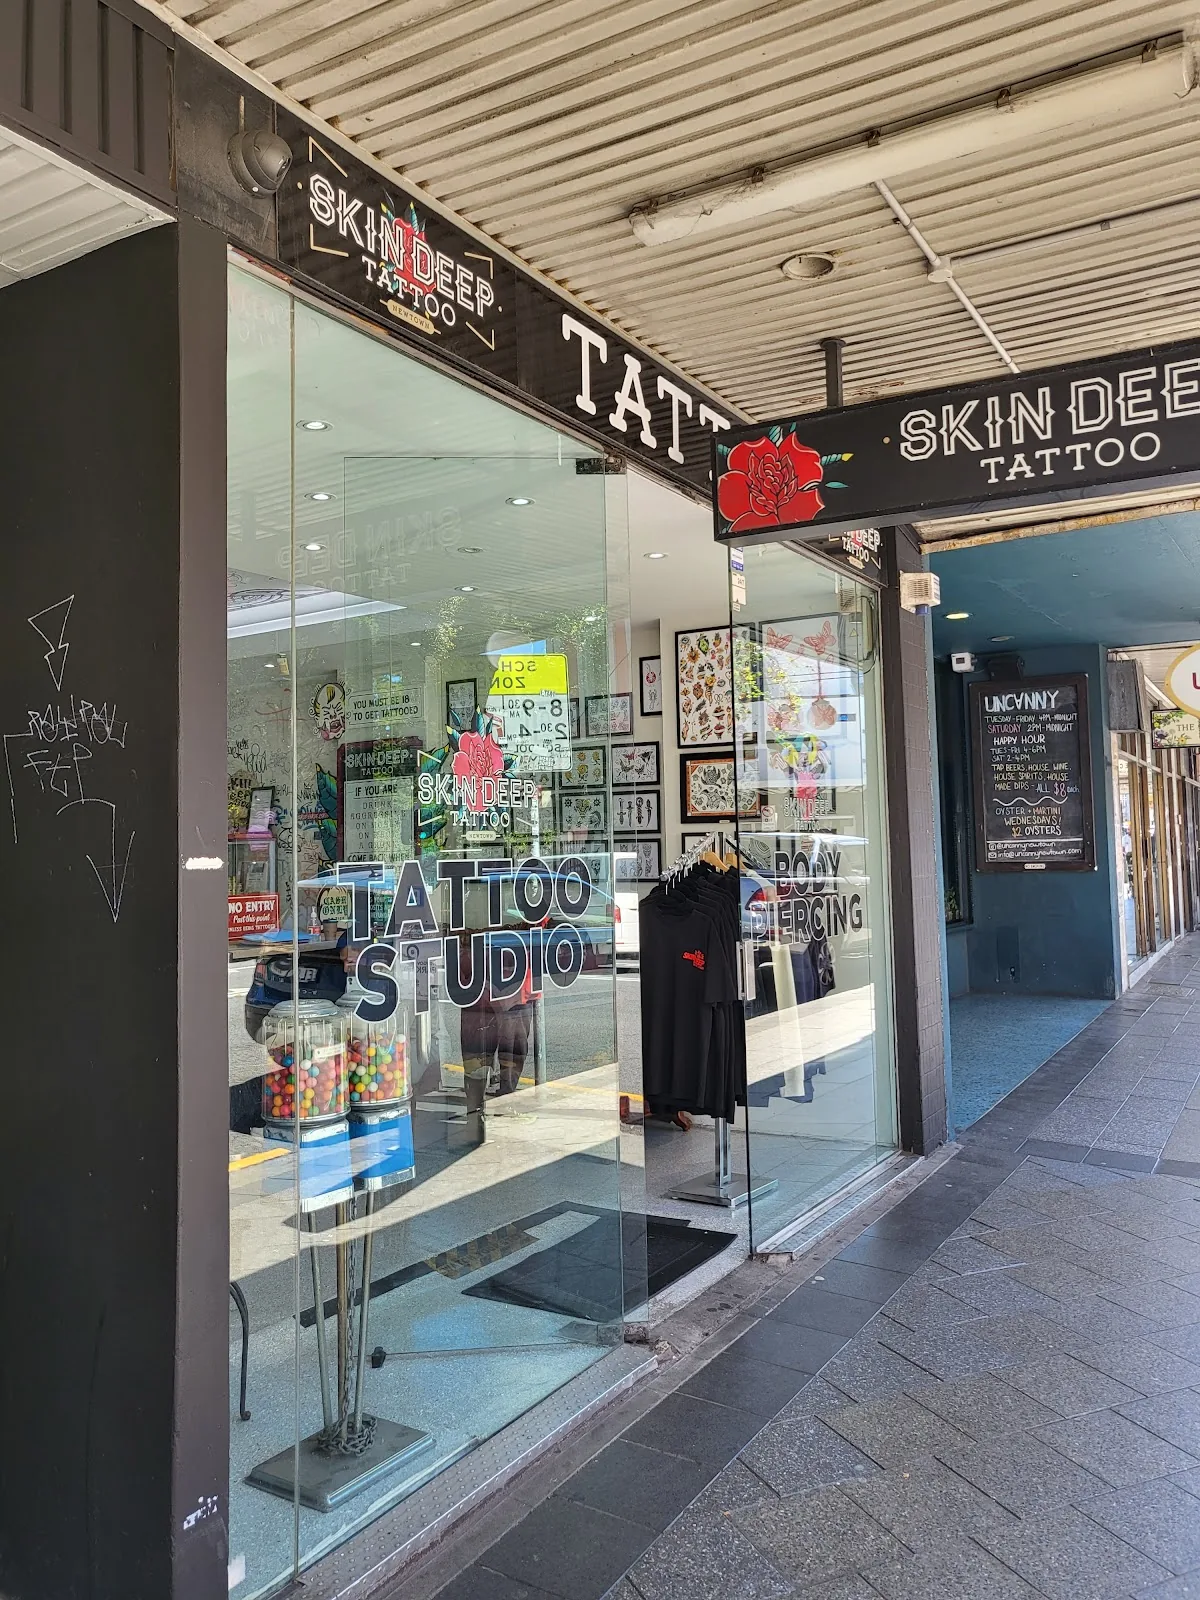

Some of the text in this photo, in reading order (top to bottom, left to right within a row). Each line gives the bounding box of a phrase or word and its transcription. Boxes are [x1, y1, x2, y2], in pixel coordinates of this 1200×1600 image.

[309, 174, 403, 271] SKIN
[410, 235, 494, 317] DEEP
[362, 256, 456, 326] TATTOO
[391, 304, 432, 331] NEWTOWN
[900, 386, 1056, 462] SKIN
[980, 431, 1161, 484] TATTOO
[353, 694, 410, 709] YOU MUST BE 18
[353, 705, 418, 721] TO GET TATTOOED
[987, 723, 1021, 734] SATURDAY
[1176, 723, 1195, 732] THE
[993, 734, 1046, 746] HAPPY HOUR
[346, 749, 410, 768] SKIN DEEP
[991, 755, 1004, 763] SAT
[361, 766, 394, 776] TATTOO
[1028, 763, 1050, 771] HOUSE
[994, 773, 1016, 781] HOUSE
[1047, 772, 1070, 781] HOUSE
[355, 784, 398, 796] IF YOU ARE
[418, 773, 537, 808] SKIN DEEP
[994, 782, 1012, 791] MADE
[1035, 783, 1051, 793] ALL
[995, 806, 1026, 816] OYSTER
[1032, 806, 1061, 816] MARTINI
[450, 811, 510, 827] TATTOO
[1024, 825, 1062, 836] OYSTERS
[773, 850, 842, 899] BODY
[337, 856, 592, 942] TATTOO
[228, 900, 276, 914] NO ENTRY
[748, 892, 863, 951] PIERCING
[353, 922, 584, 1024] STUDIO
